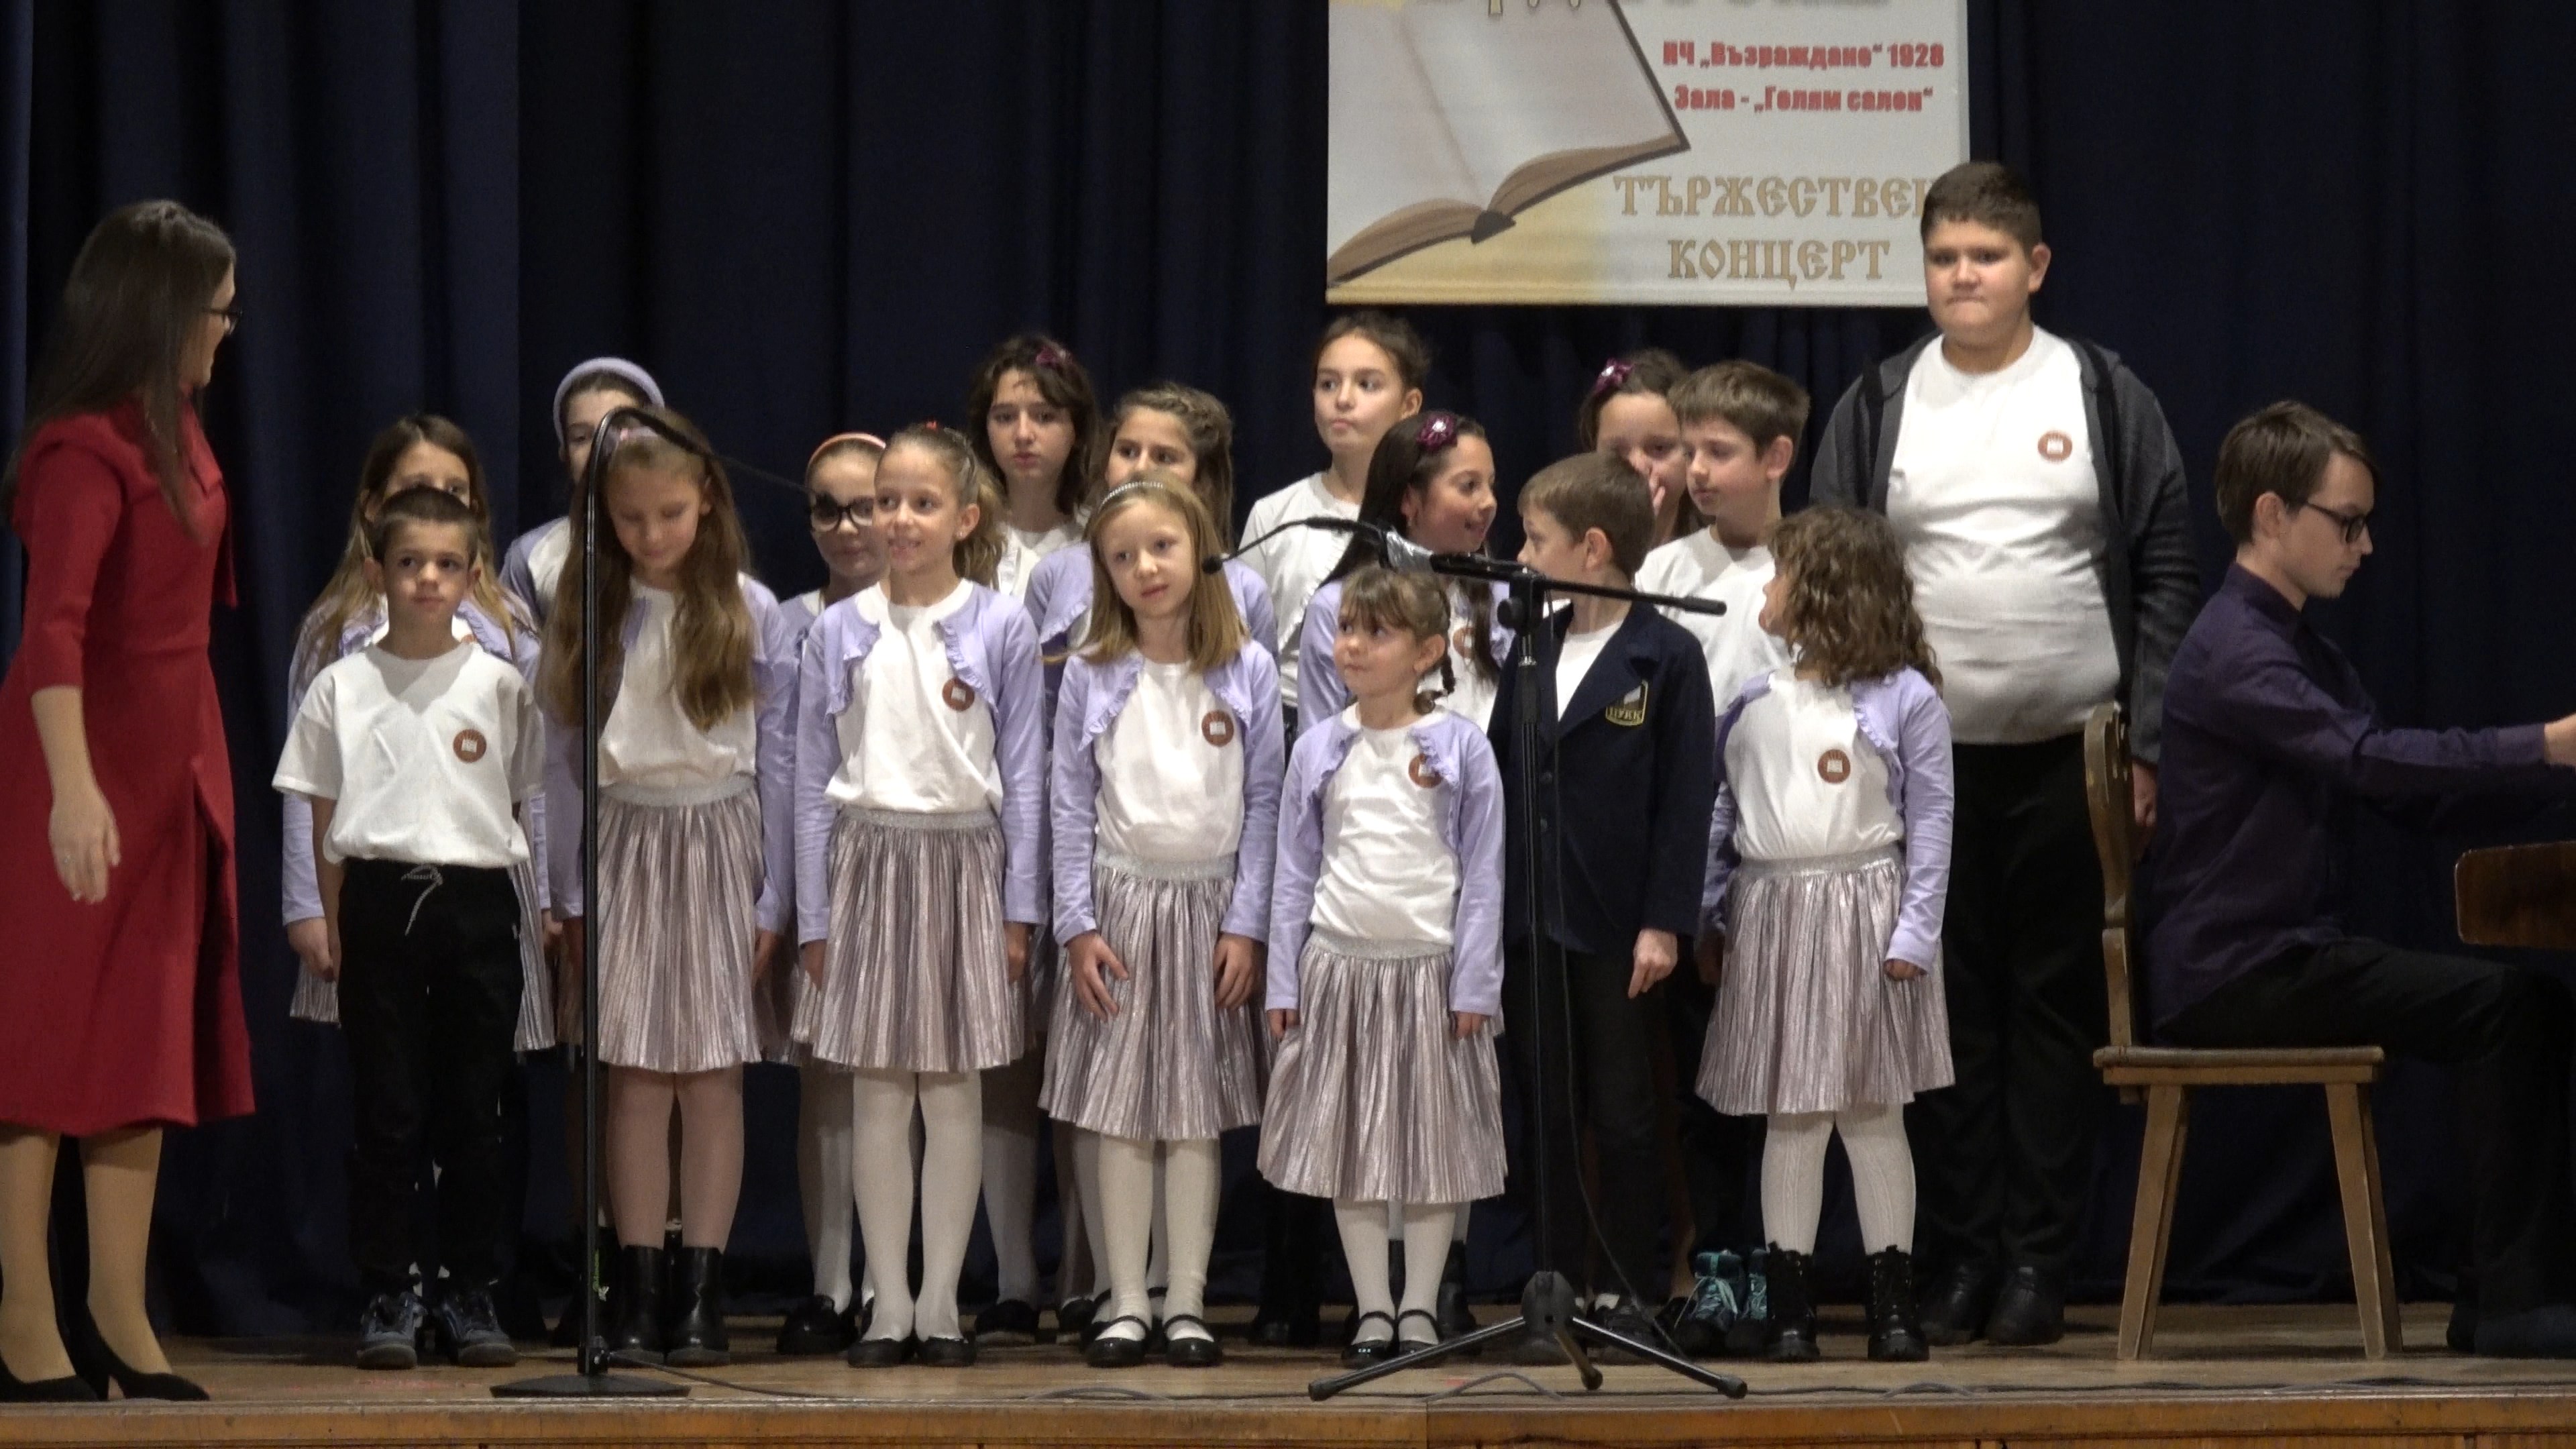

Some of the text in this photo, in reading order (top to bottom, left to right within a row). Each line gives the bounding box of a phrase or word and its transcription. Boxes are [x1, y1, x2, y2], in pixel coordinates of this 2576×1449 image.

[1886, 43, 1944, 68] 1928
[1674, 84, 1735, 110] Зала
[1668, 239, 1890, 290] КОНЦЕРТ
